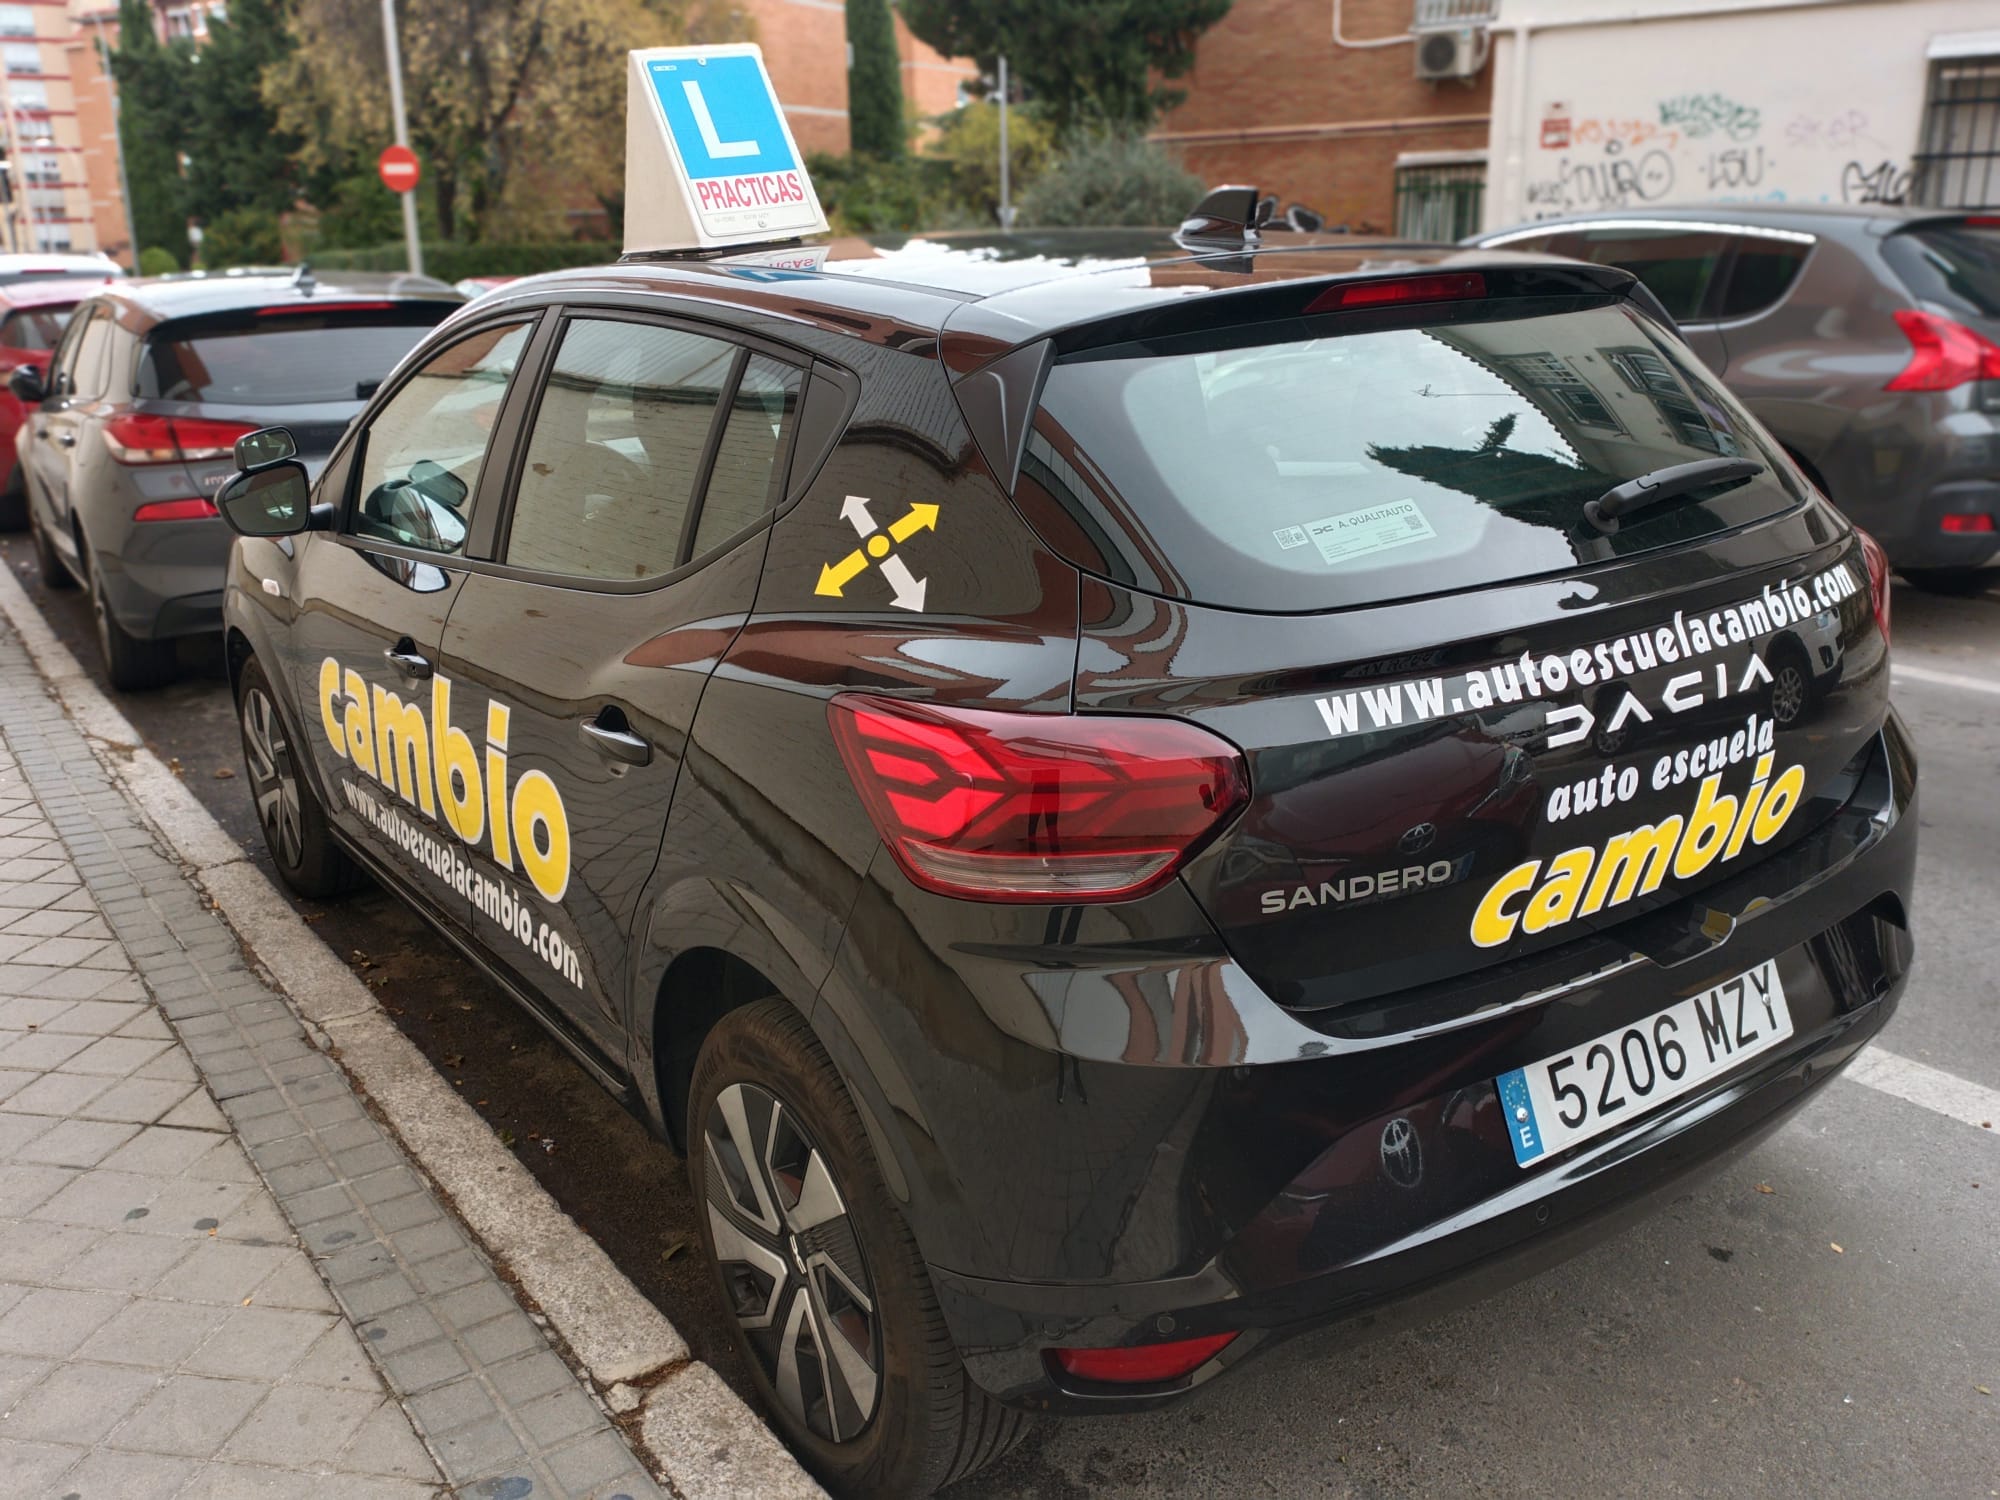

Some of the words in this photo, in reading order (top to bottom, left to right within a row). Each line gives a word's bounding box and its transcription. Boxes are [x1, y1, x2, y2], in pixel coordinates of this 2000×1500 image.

[682, 80, 761, 159] L
[696, 172, 804, 210] PRACTICAS
[1349, 504, 1414, 526] QUALITAUTO
[1545, 653, 1774, 749] DACIA
[319, 657, 571, 904] cambio
[1547, 764, 1639, 823] auto
[1652, 714, 1774, 792] escuela
[341, 778, 583, 990] www.autoescuelacambio.com
[1260, 861, 1452, 914] SANDERO
[1470, 749, 1806, 948] cambio
[1547, 1014, 1687, 1129] 5206
[1694, 964, 1777, 1063] MZY
[1519, 1127, 1534, 1149] E
